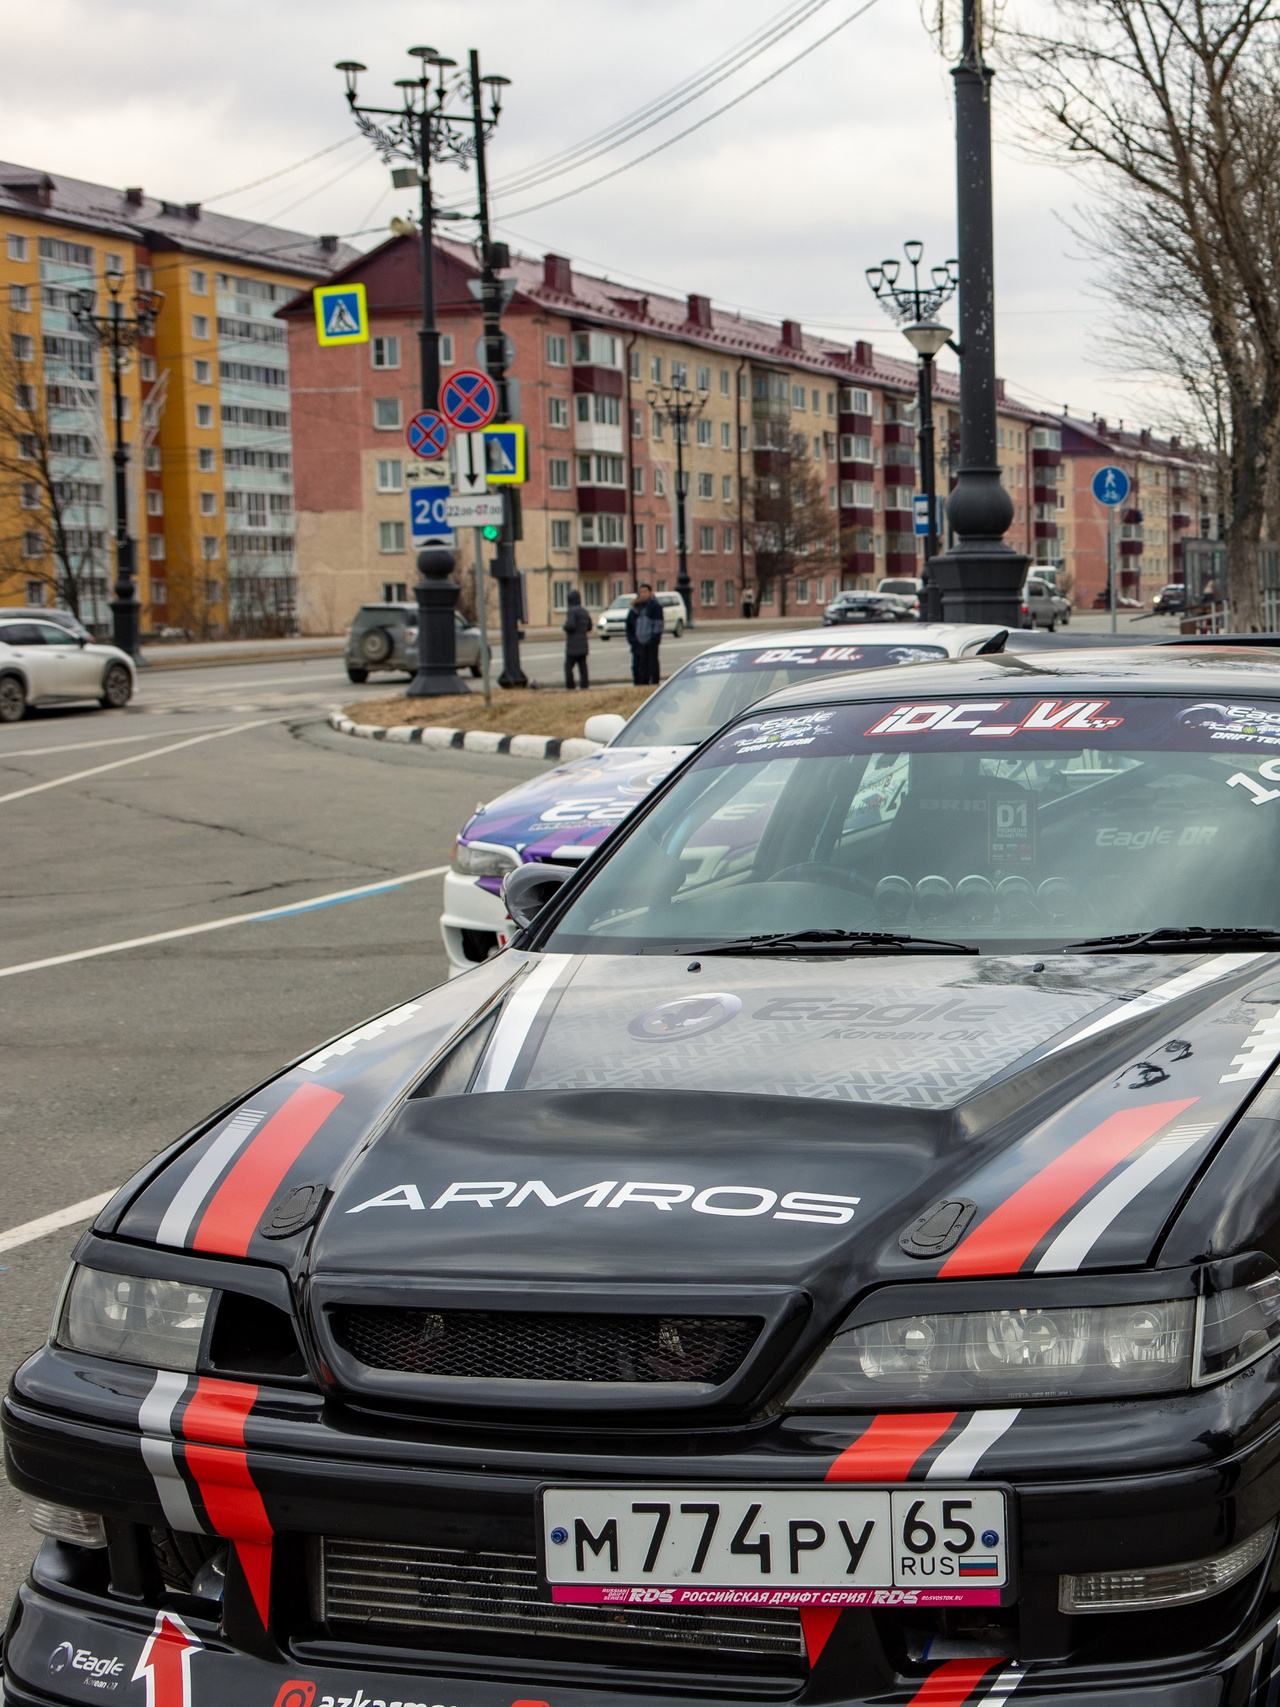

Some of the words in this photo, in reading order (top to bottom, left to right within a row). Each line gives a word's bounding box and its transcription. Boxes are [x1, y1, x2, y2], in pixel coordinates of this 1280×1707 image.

[758, 710, 836, 732] Eagle
[736, 741, 777, 755] DRIFT
[776, 737, 816, 749] TEAM
[1210, 731, 1257, 742] DRIFT
[996, 803, 1028, 828] D1
[1095, 826, 1173, 850] Eagle
[751, 997, 1008, 1028] Eagle
[820, 1028, 933, 1041] Korean
[937, 1029, 990, 1042] Oil
[344, 1180, 862, 1225] ARMROS
[902, 1499, 976, 1554] 65
[901, 1556, 955, 1576] RUS
[629, 1587, 677, 1603] RDS
[680, 1589, 768, 1604] РОССИЙСКАЯ
[769, 1592, 820, 1605] ДРИФТ
[820, 1592, 868, 1604] СЕРИЯ
[871, 1589, 922, 1604] RDS
[71, 1649, 125, 1677] Eagle
[83, 1676, 107, 1689] Korean
